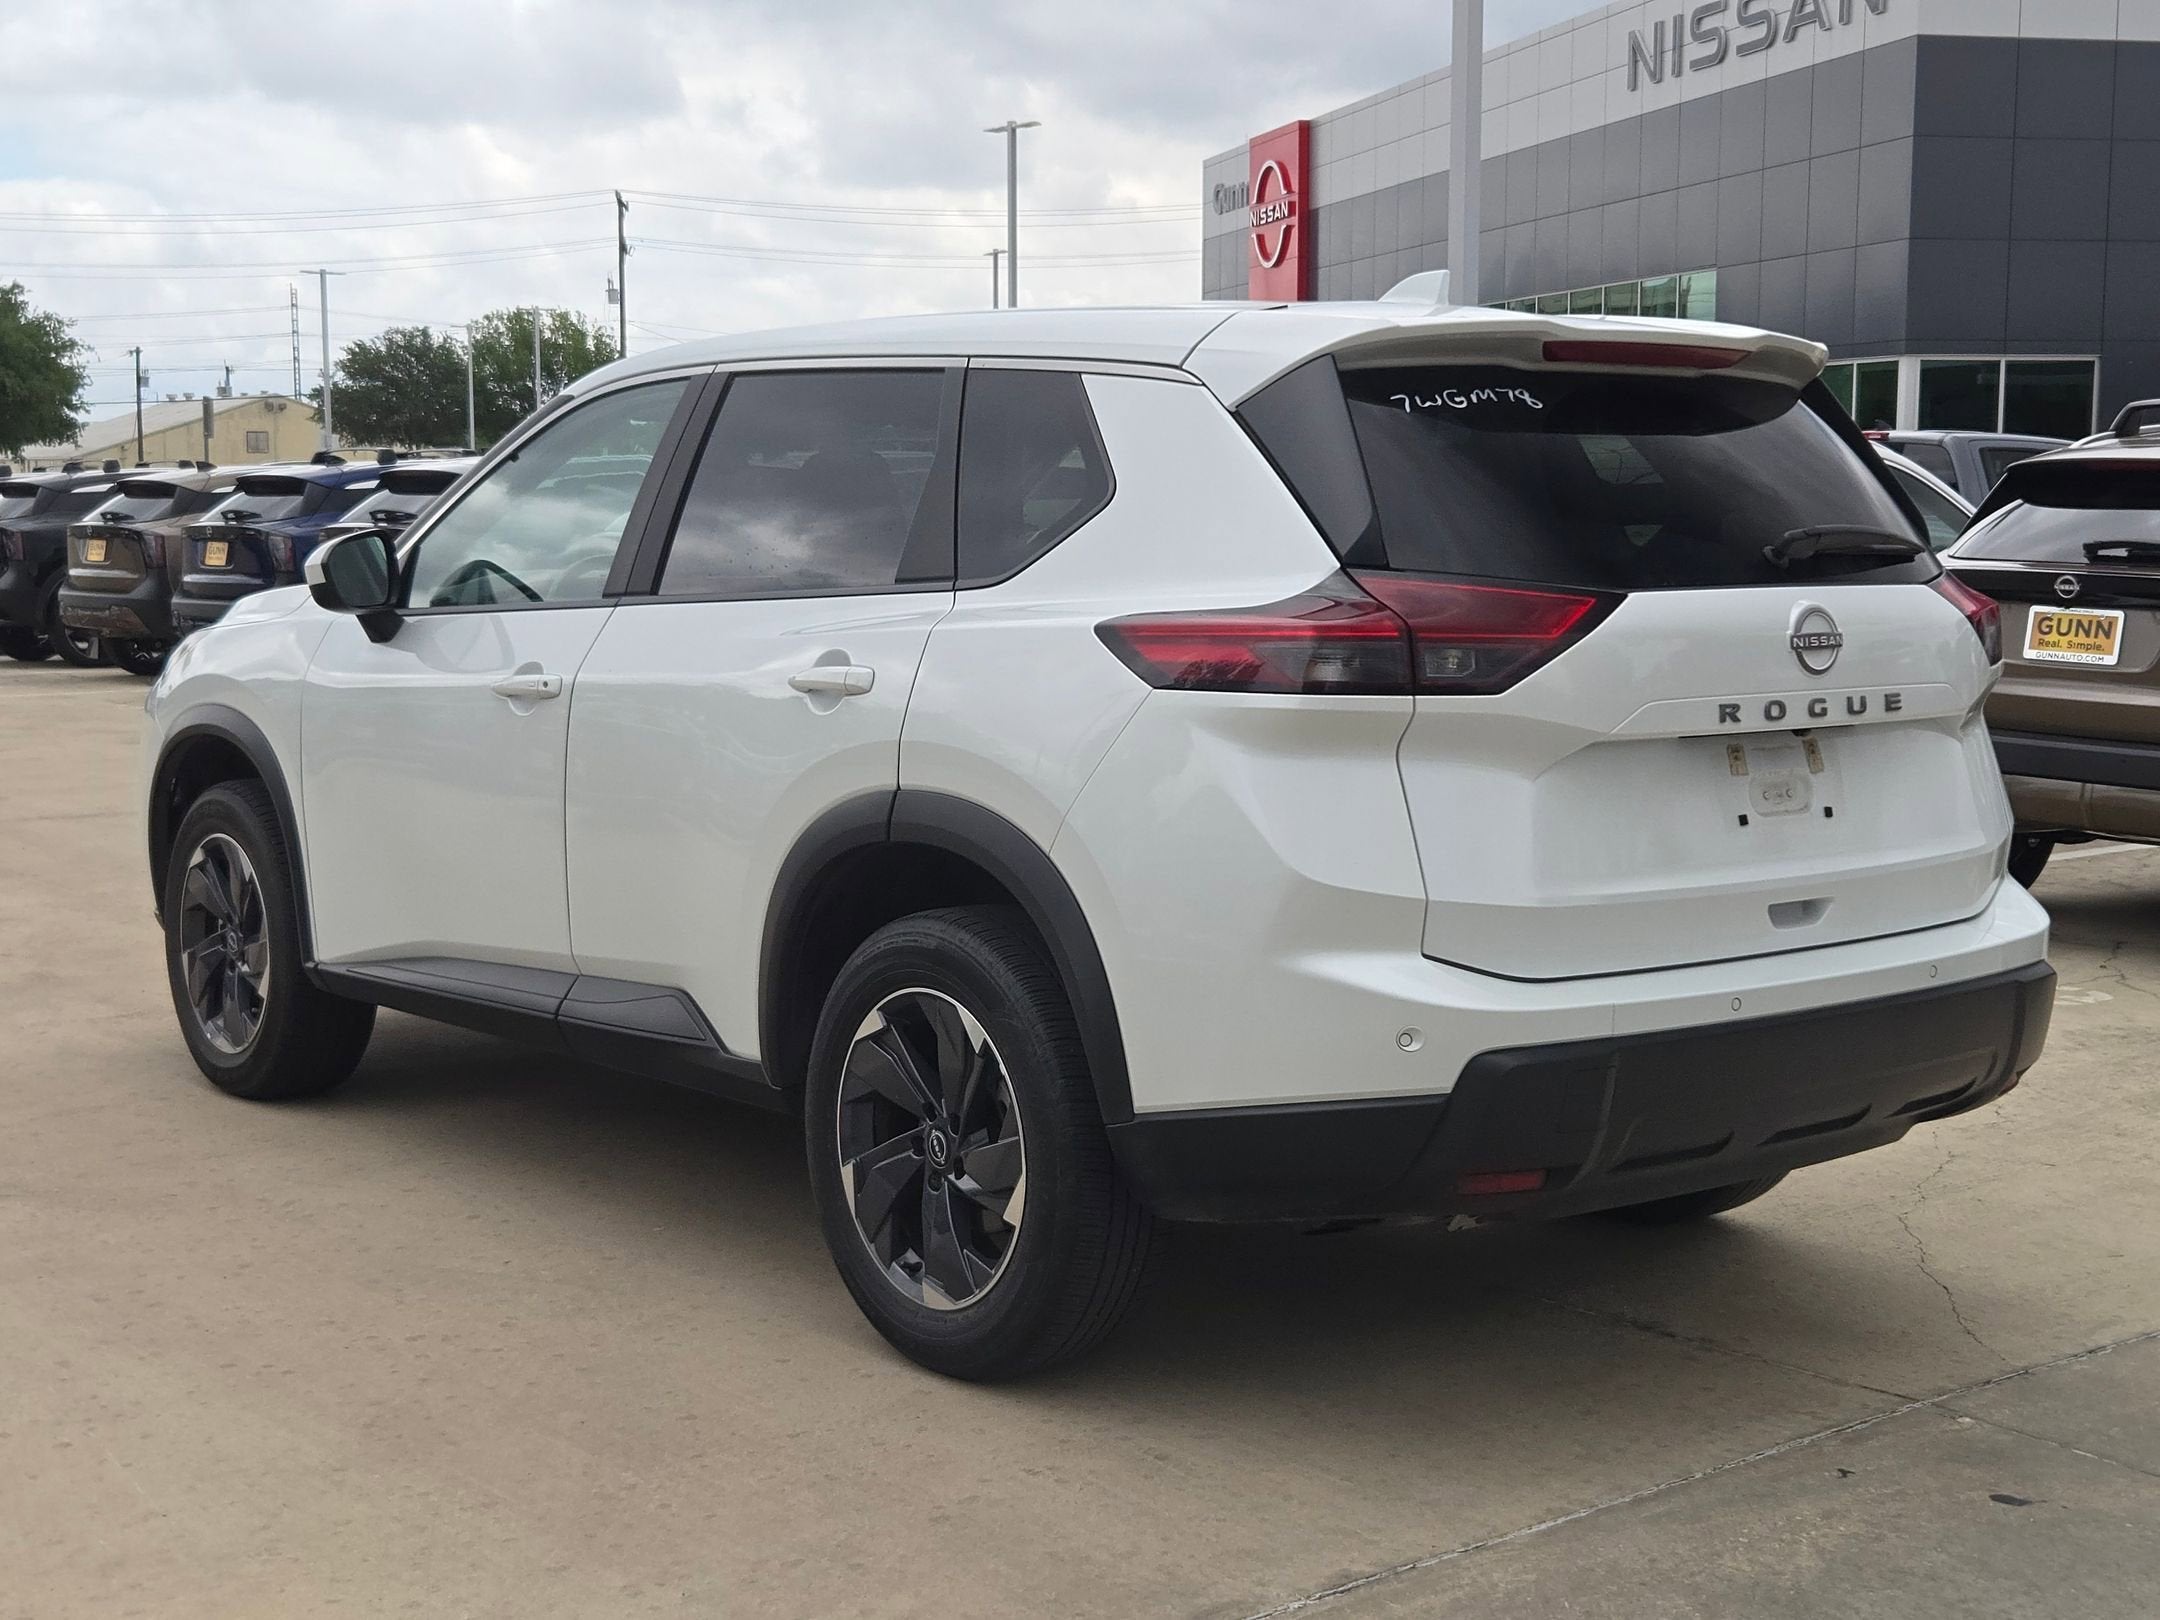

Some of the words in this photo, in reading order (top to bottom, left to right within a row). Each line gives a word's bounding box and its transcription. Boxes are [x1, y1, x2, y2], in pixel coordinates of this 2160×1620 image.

[1249, 200, 1289, 228] NISSAN
[1390, 388, 1544, 413] 7WGM78
[2037, 616, 2113, 640] GUNN
[1792, 635, 1844, 648] NISSAN
[2038, 638, 2062, 649] Real.
[2066, 640, 2105, 652] Simple.
[2035, 652, 2105, 663] GUNNAUTO.COM
[1719, 692, 1903, 724] ROGUE
